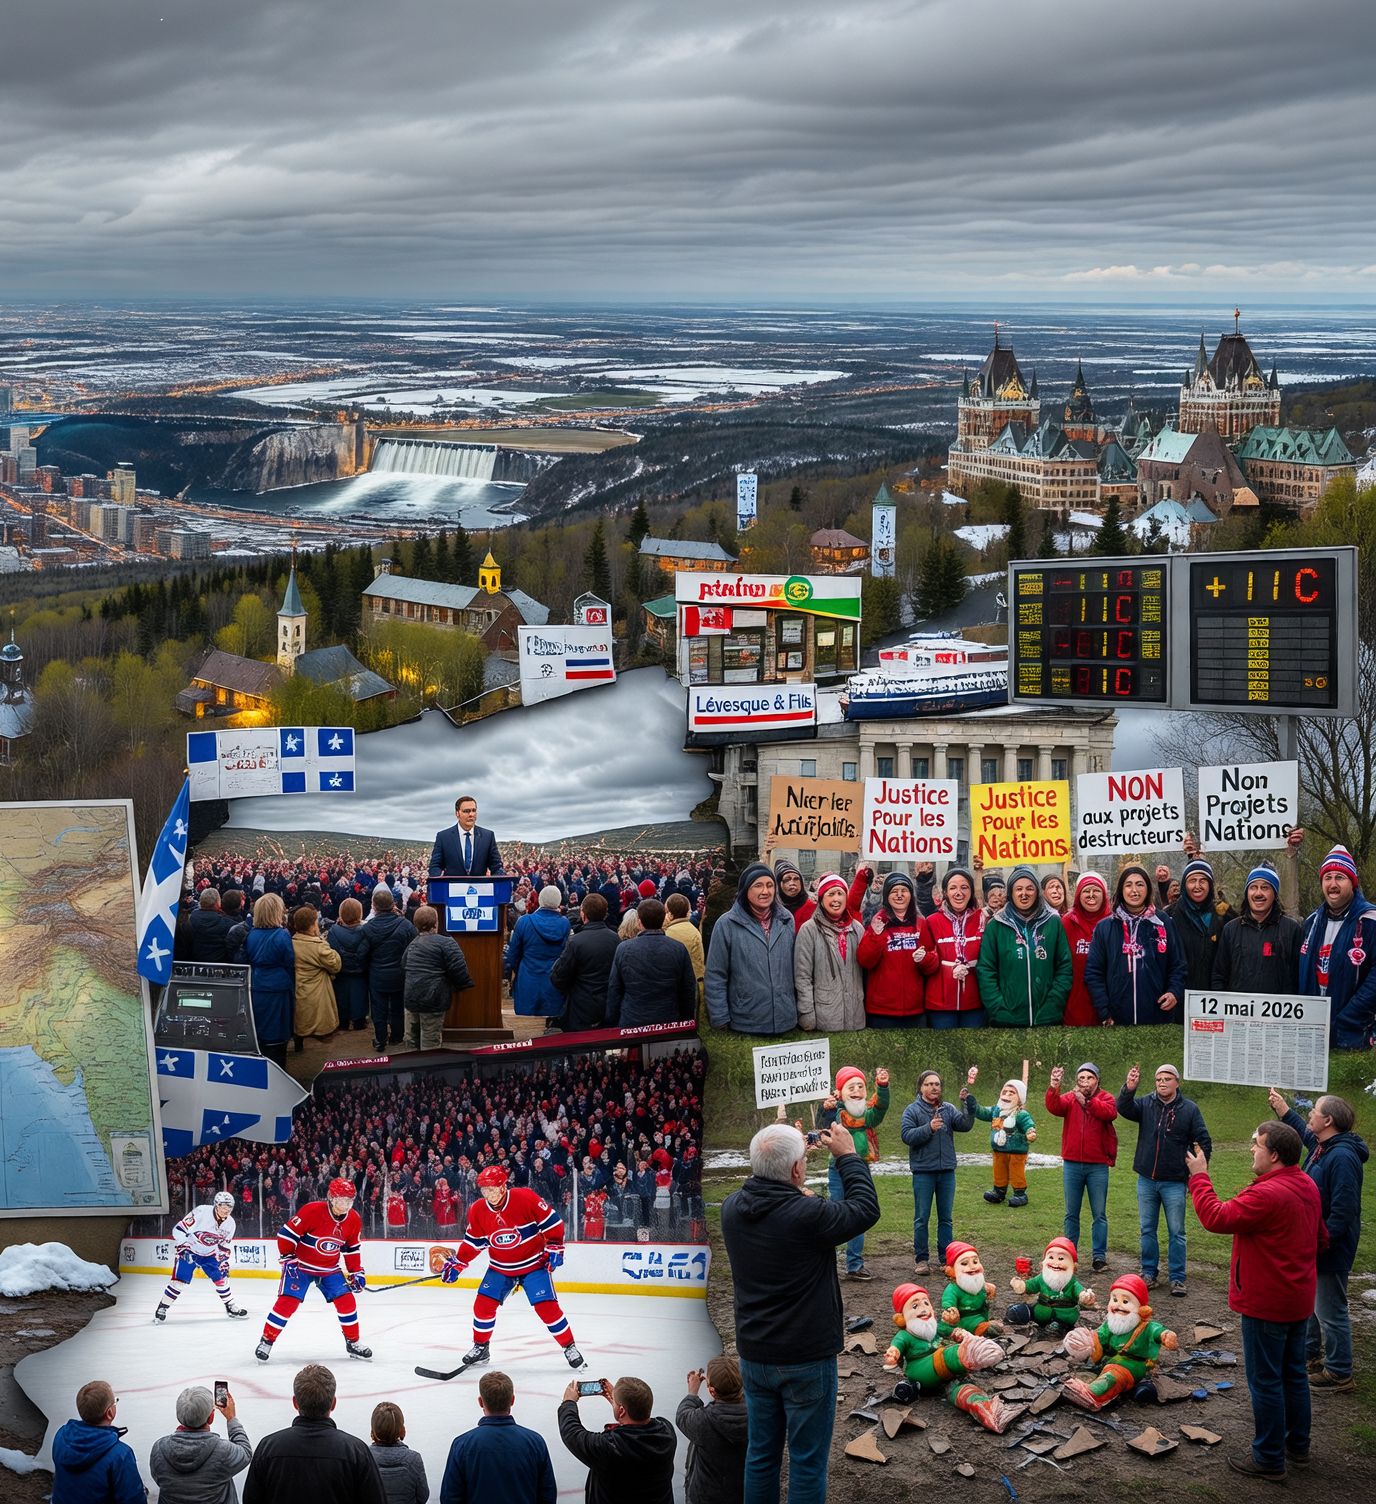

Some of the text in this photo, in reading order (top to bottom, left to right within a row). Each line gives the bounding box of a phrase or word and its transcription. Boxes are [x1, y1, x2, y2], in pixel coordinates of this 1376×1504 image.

[696, 695, 769, 715] Lévesque
[773, 694, 784, 709] &
[1107, 772, 1163, 801] NON
[1221, 767, 1268, 792] Non
[874, 780, 949, 805] Justice
[979, 785, 1057, 811] Justice
[920, 807, 945, 827] les
[1082, 802, 1179, 828] aux projets
[1206, 793, 1288, 820] Projets
[1031, 810, 1059, 829] les
[1204, 817, 1292, 842] Nations
[868, 828, 953, 854] Nations
[978, 833, 1068, 860] Nations
[1078, 827, 1183, 849] destructeurs
[1199, 997, 1304, 1019] 12 mai 2026
